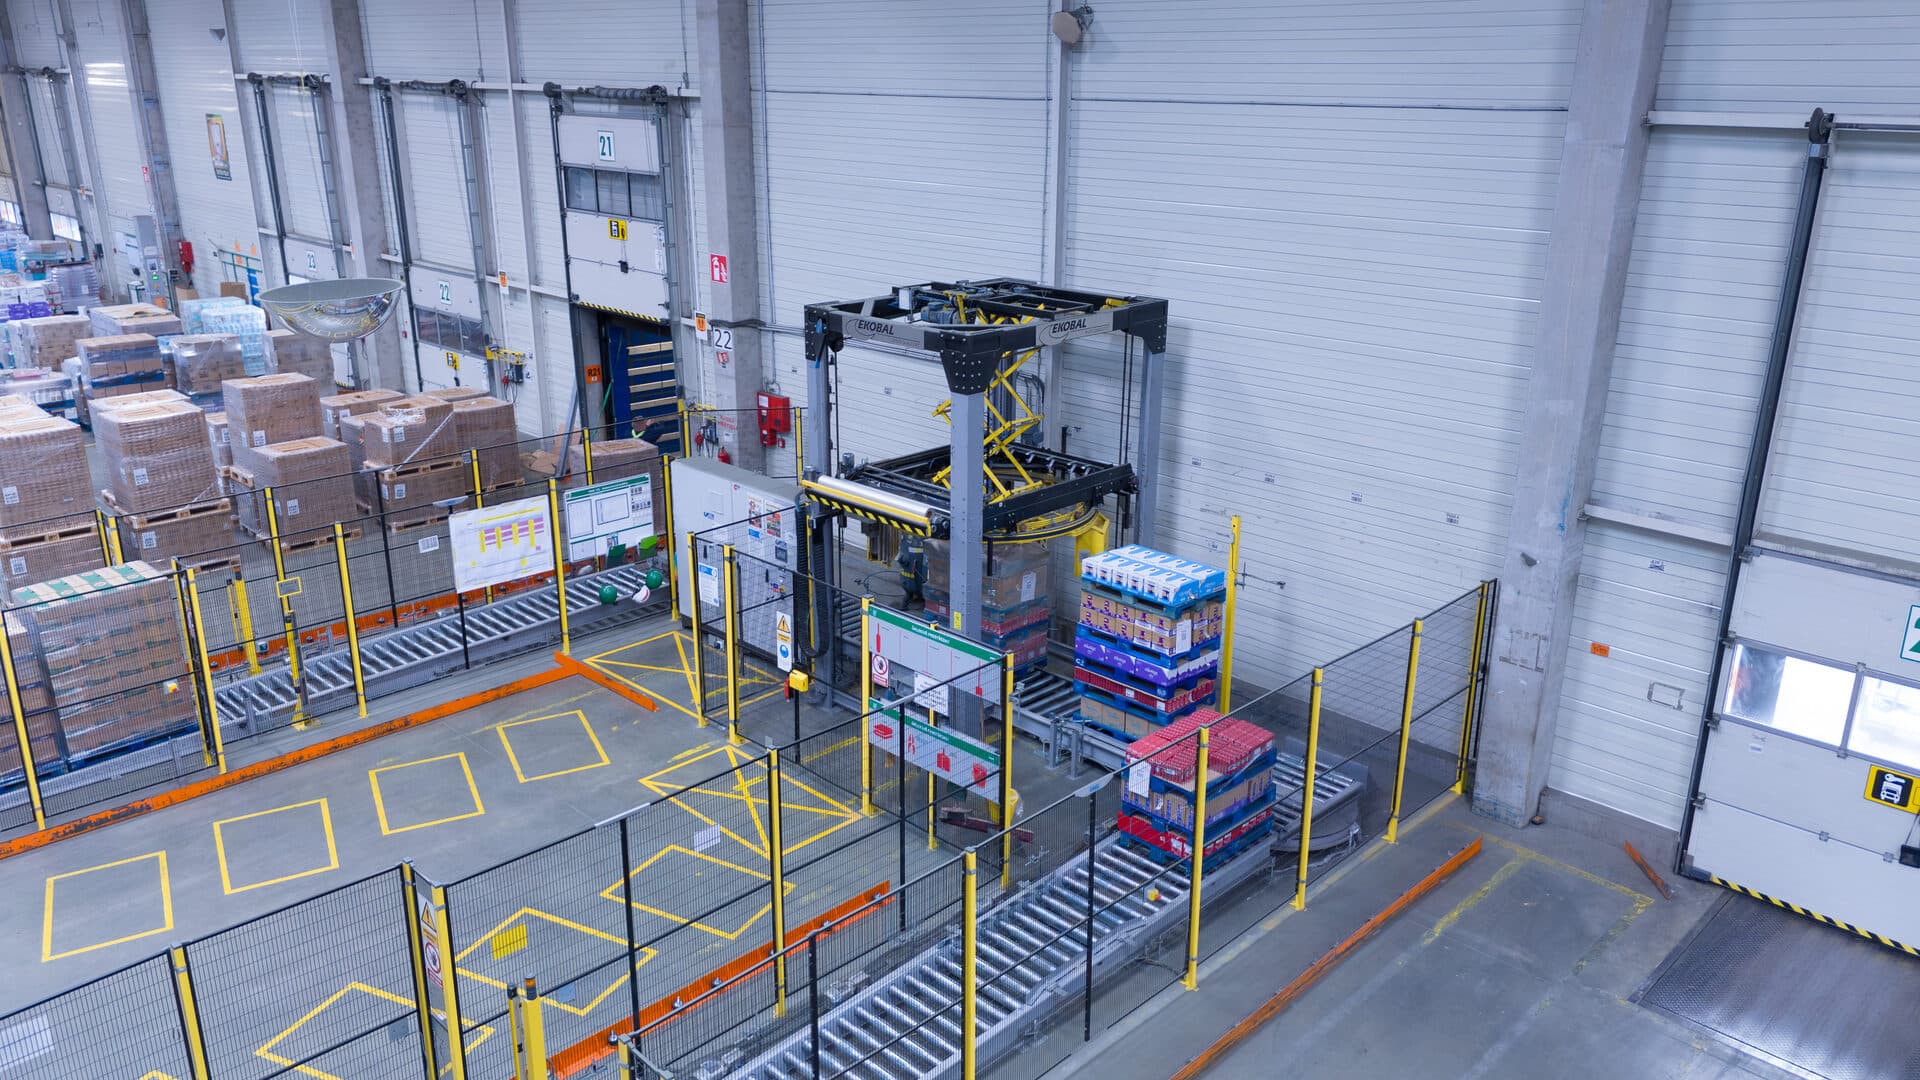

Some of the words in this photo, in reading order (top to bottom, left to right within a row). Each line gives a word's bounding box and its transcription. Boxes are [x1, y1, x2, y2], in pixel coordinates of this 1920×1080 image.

[599, 135, 612, 157] 21
[439, 283, 450, 301] 22
[857, 319, 895, 336] EKOBAL
[1052, 318, 1087, 333] EKOBAL
[714, 328, 732, 350] 22
[588, 367, 601, 377] R21
